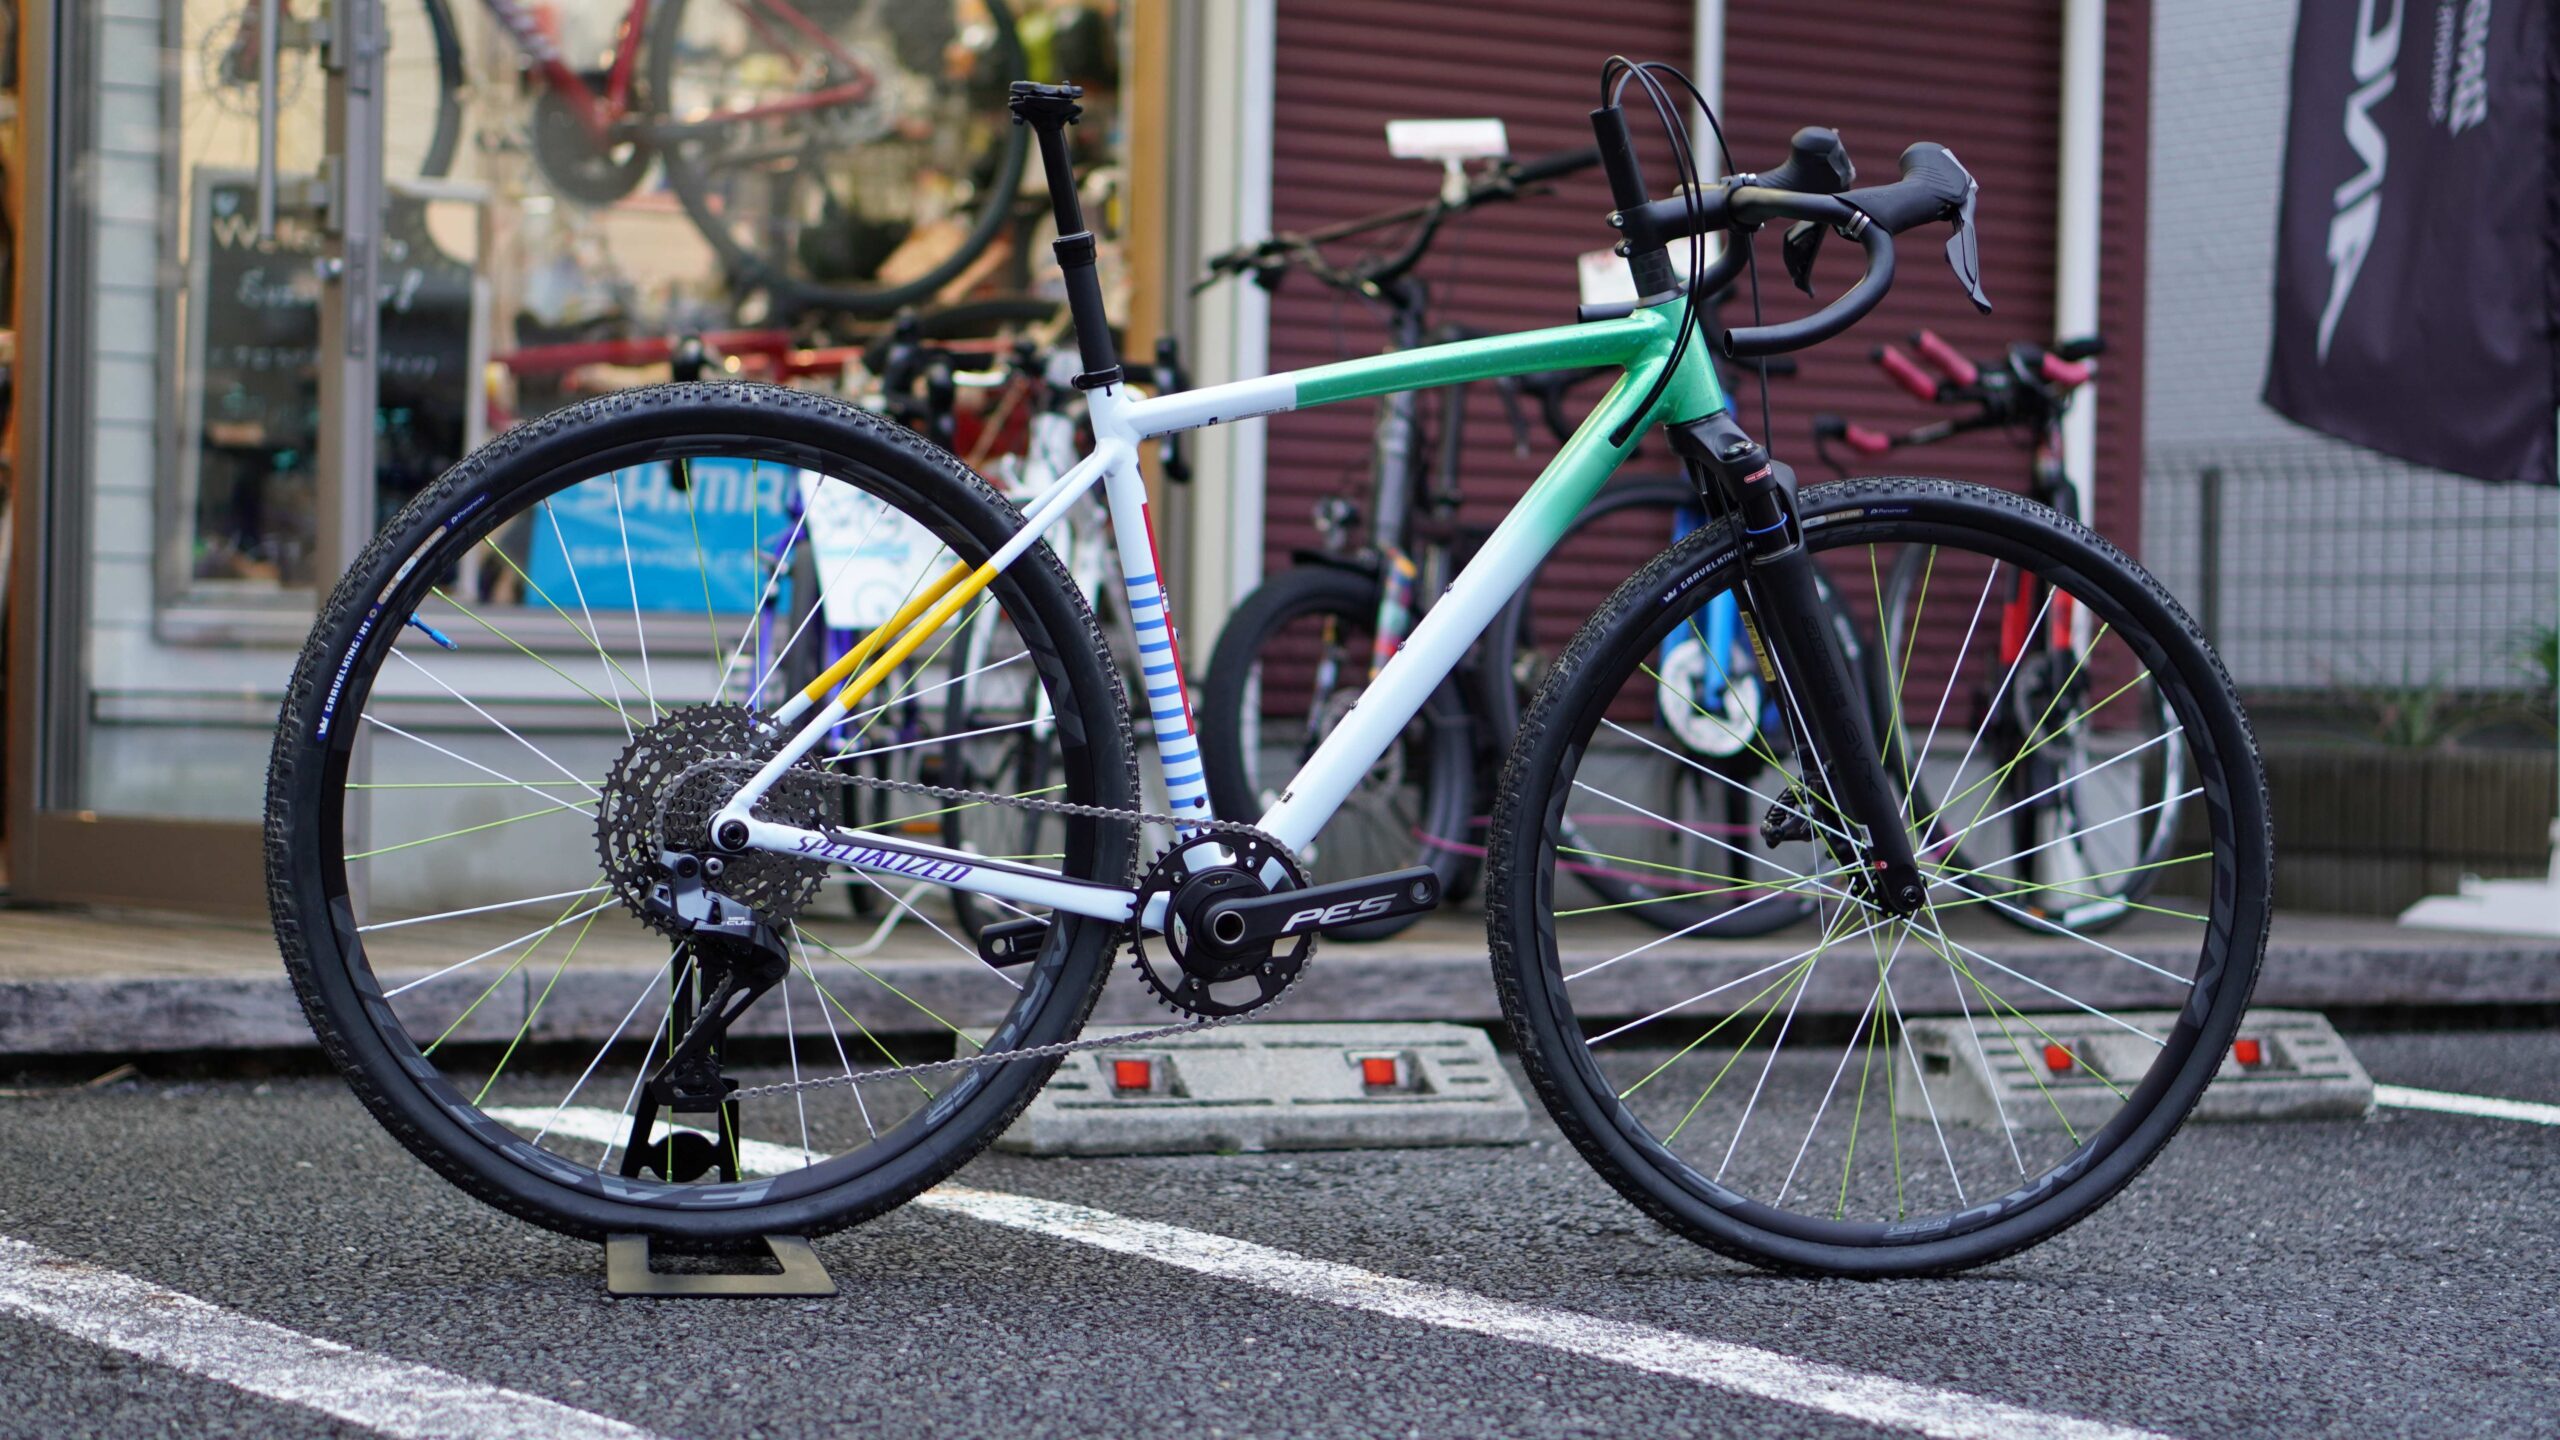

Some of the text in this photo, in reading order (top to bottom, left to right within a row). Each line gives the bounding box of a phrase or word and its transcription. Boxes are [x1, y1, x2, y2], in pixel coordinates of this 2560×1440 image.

[575, 461, 799, 513] SHMA
[325, 640, 361, 713] GRAVELKING
[788, 835, 974, 883] SPECIALIZED
[1281, 893, 1398, 933] PES
